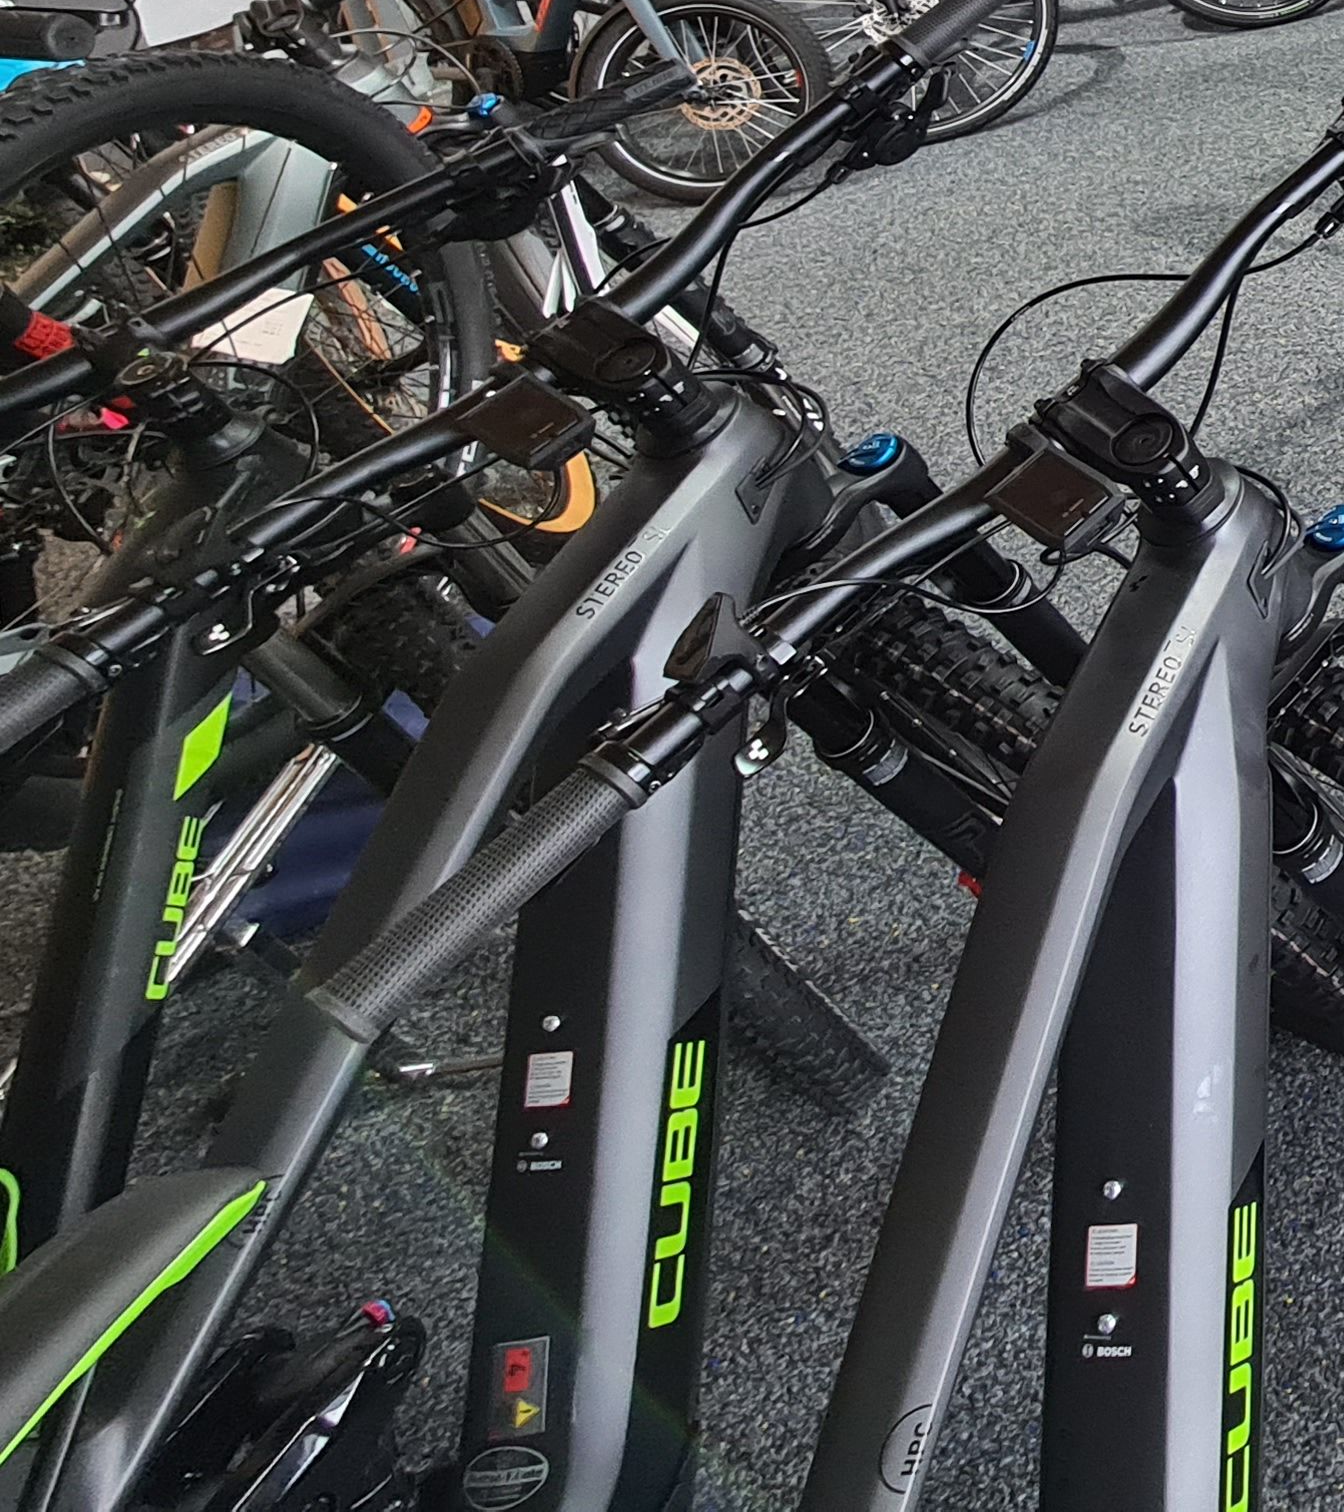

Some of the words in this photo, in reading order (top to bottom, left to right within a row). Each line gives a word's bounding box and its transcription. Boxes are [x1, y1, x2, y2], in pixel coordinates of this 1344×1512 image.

[576, 550, 643, 620] STEREO
[1128, 656, 1182, 737] STEREO
[145, 815, 204, 1000] CUBE
[649, 1040, 705, 1328] CUBE
[1097, 1346, 1132, 1358] BOSCH
[1225, 1201, 1257, 1512] CUBE
